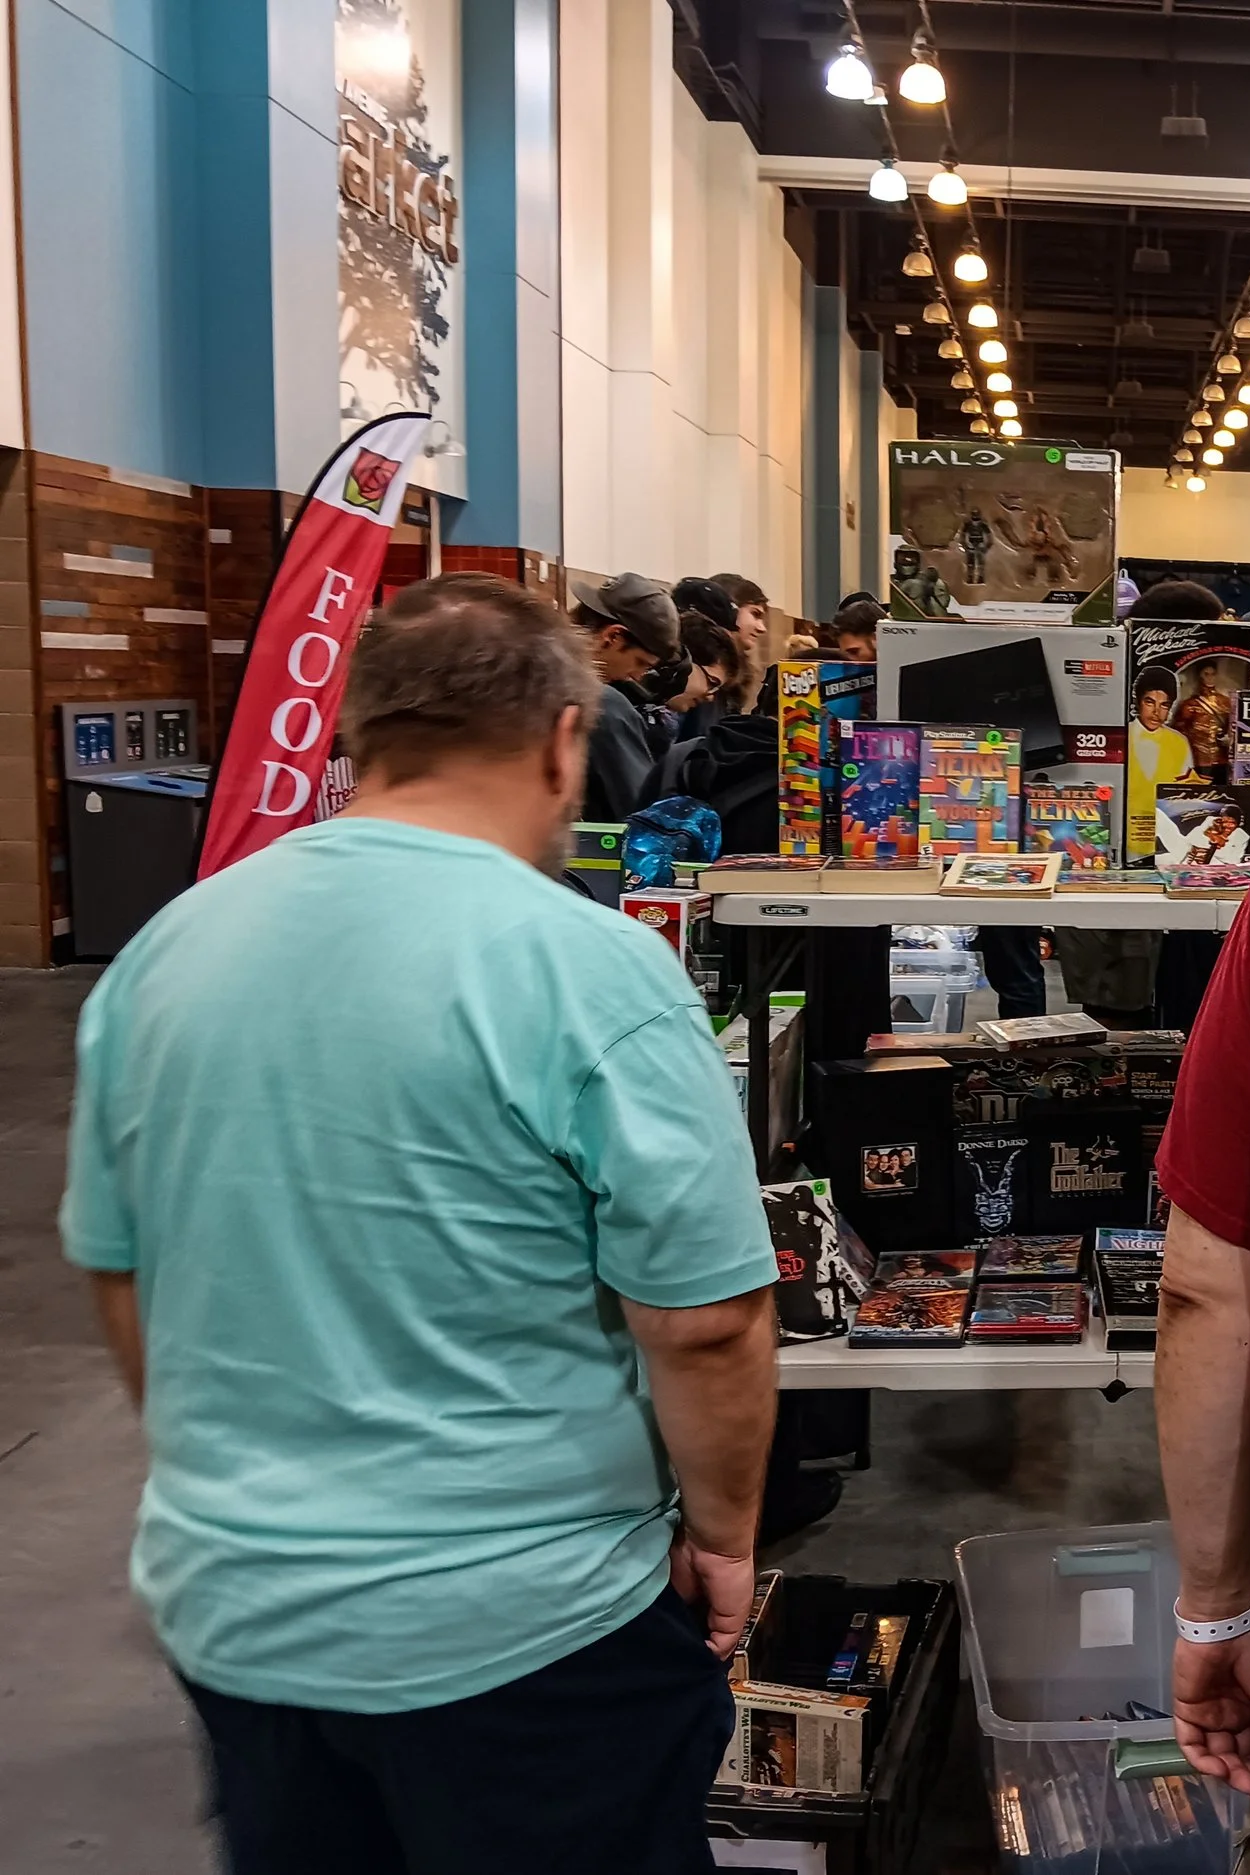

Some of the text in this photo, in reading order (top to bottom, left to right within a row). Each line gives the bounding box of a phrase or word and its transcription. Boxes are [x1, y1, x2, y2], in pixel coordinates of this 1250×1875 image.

[895, 448, 1006, 466] HALO
[882, 627, 918, 635] SONY
[1132, 624, 1206, 646] Michael
[1135, 638, 1208, 665] Jackson
[252, 567, 355, 817] FOOD
[1076, 733, 1107, 748] 320
[936, 753, 1006, 777] TETRIS
[1028, 800, 1101, 821] TETRIS
[958, 1139, 996, 1152] DONNIE
[1050, 1142, 1081, 1166] The
[1050, 1165, 1128, 1193] Godfather
[734, 1694, 787, 1706] HARLOTTE'S
[741, 1708, 750, 1728] WEB
